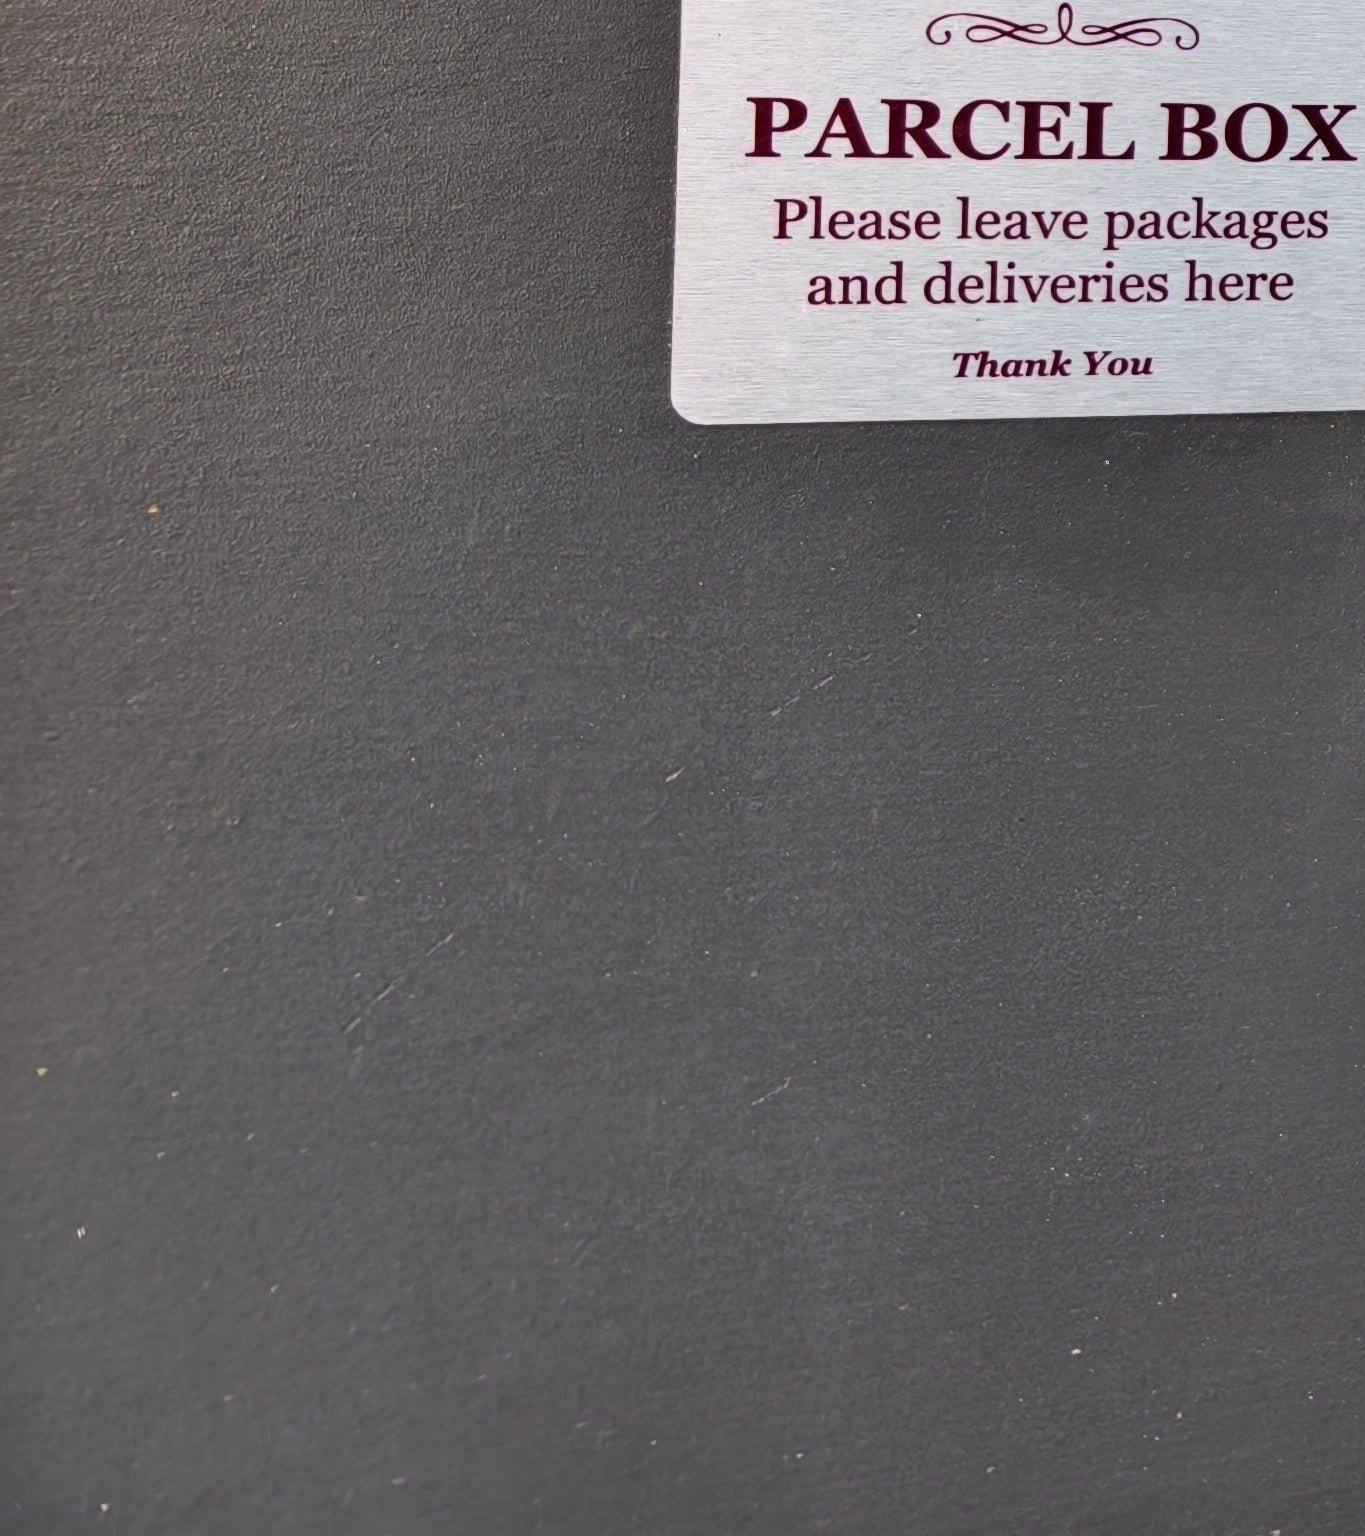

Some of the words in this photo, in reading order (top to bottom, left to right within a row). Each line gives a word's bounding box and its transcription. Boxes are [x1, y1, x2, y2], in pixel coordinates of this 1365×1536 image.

[745, 97, 1135, 160] PARCEL
[1159, 103, 1357, 162] BOX
[773, 196, 940, 240] Please
[957, 197, 1088, 239] leave
[1103, 197, 1328, 250] packages
[808, 261, 907, 305] and
[924, 261, 1168, 304] deliveries
[1185, 260, 1293, 301] here
[953, 350, 1072, 378] Thank
[1083, 351, 1152, 376] You
